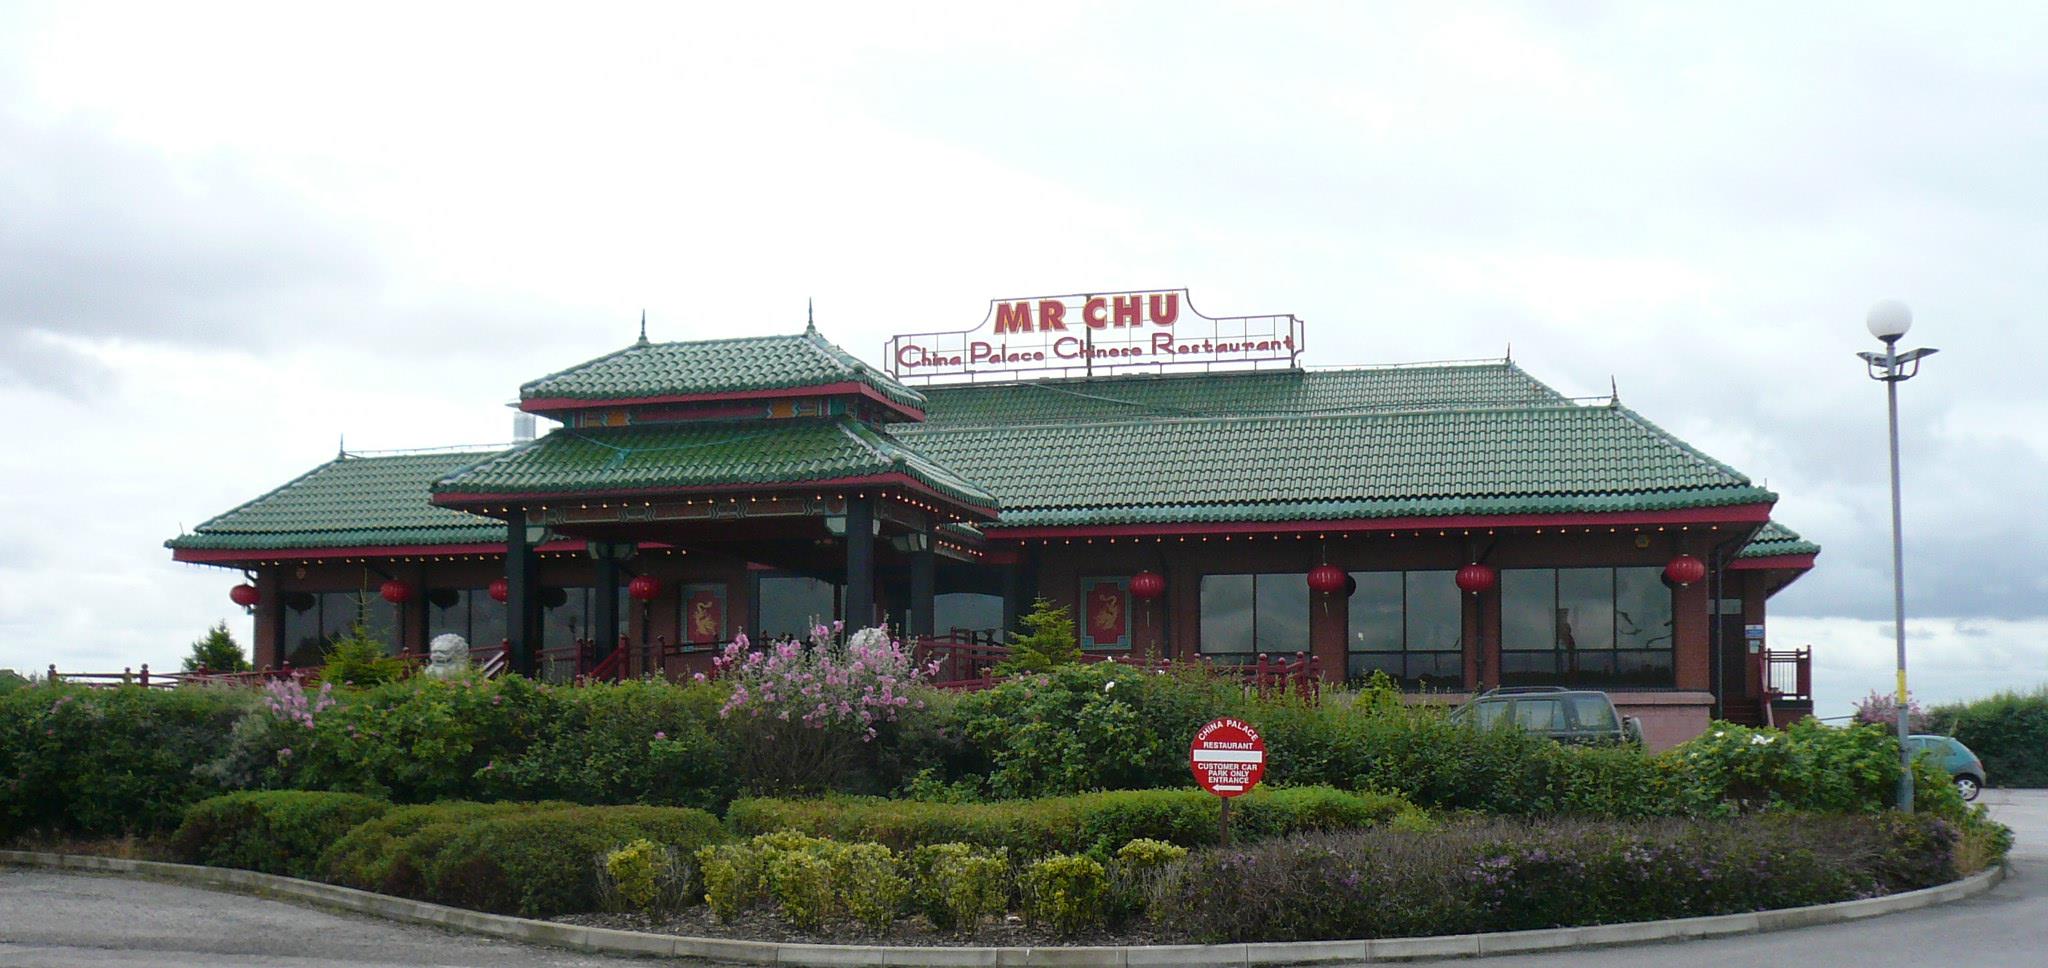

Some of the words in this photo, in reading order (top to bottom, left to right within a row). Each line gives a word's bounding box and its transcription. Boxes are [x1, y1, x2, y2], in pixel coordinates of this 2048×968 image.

[994, 300, 1069, 335] MR
[1083, 293, 1179, 330] CHU
[897, 345, 962, 368] China
[970, 342, 1045, 364] Palace
[1053, 336, 1143, 360] Chinese
[1151, 332, 1295, 356] Restaurant
[1198, 720, 1224, 741] CHINA
[1226, 719, 1259, 742] PALACE
[1203, 741, 1254, 750] RESTAURANT
[1197, 762, 1239, 770] CUSTOMER
[1241, 763, 1258, 771] CAR
[1208, 769, 1228, 777] PARK
[1208, 776, 1250, 784] ENTRANCE
